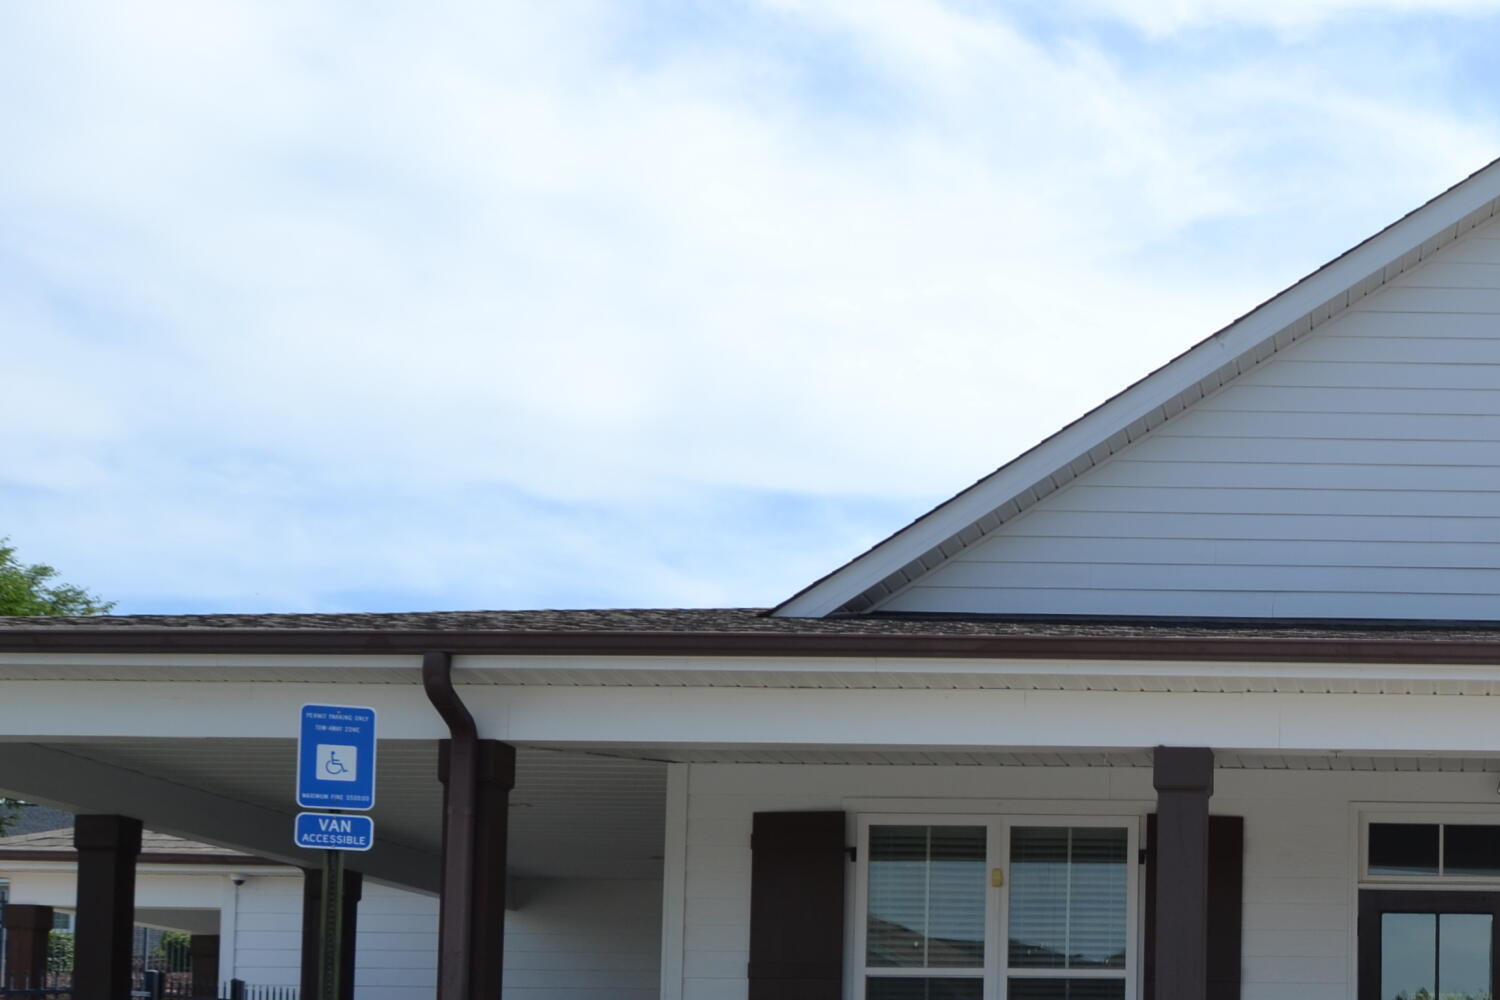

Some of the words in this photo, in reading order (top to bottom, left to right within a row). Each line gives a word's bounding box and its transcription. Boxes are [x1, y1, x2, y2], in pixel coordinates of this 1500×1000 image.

[329, 713, 352, 721] PARKING
[318, 818, 351, 833] VAN
[302, 833, 366, 846] ACCESSIBLE
